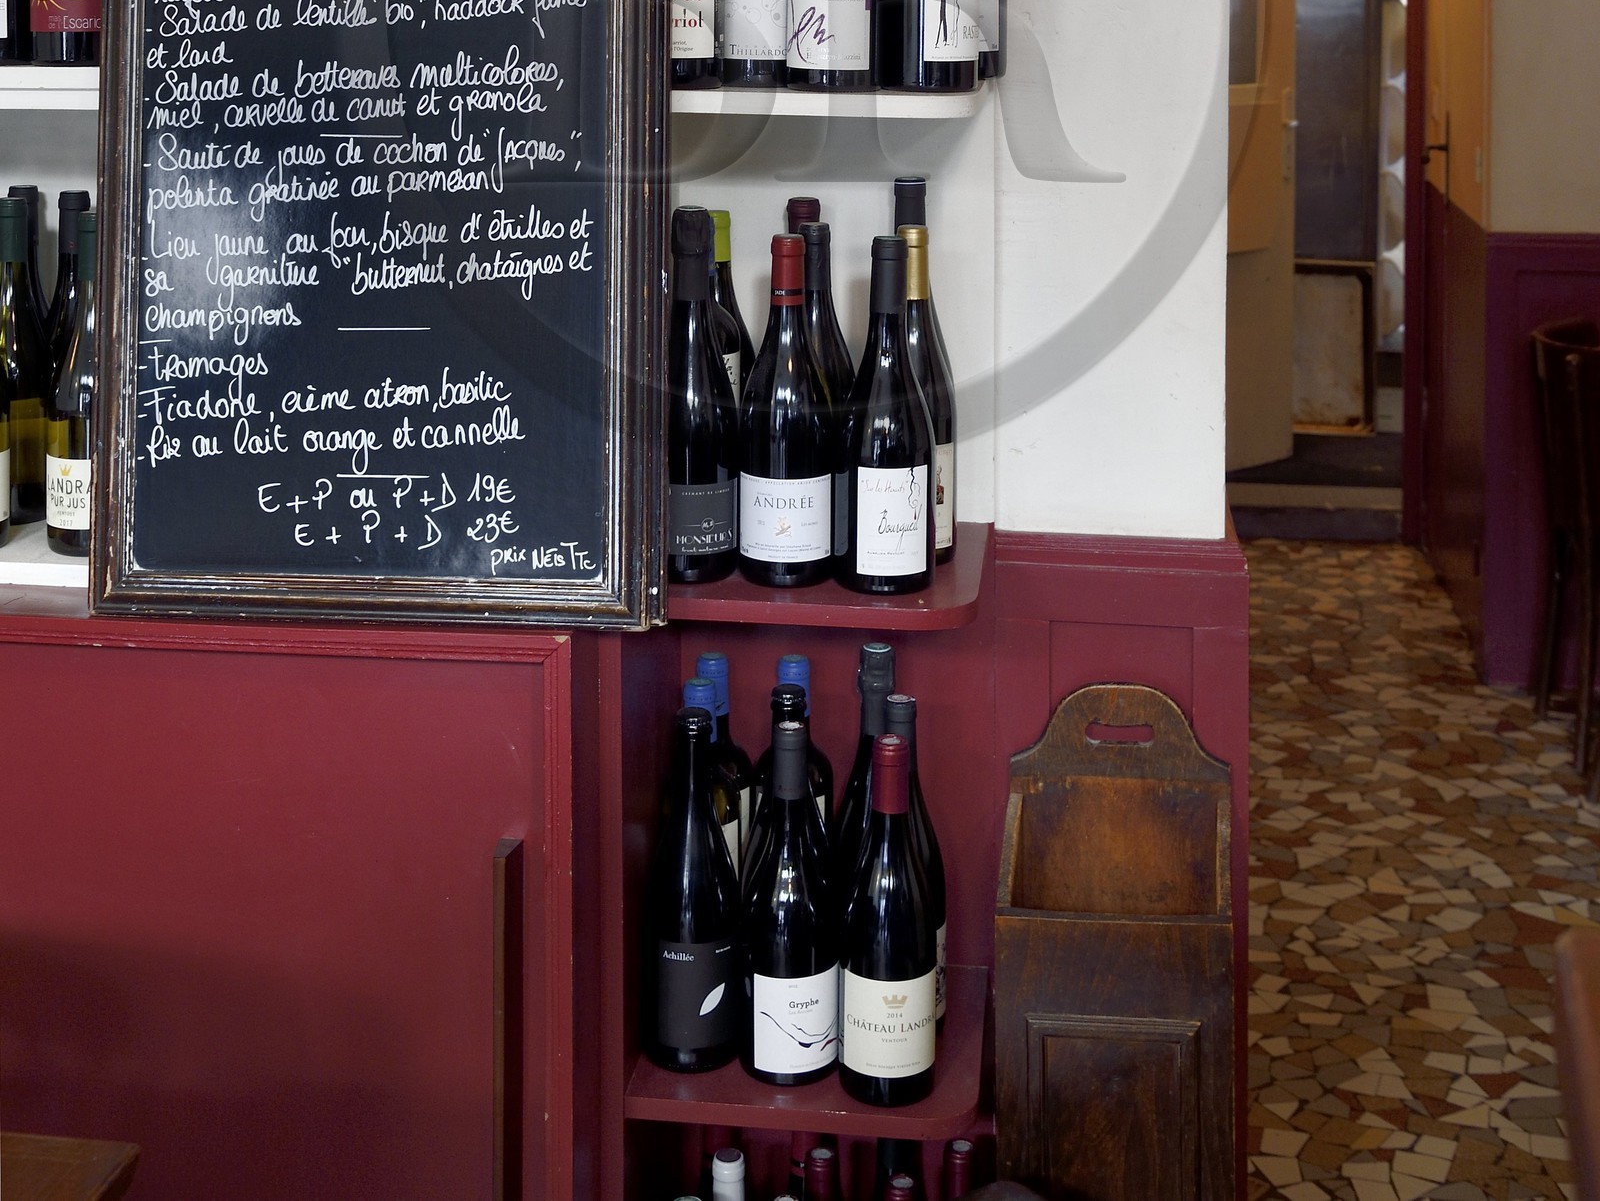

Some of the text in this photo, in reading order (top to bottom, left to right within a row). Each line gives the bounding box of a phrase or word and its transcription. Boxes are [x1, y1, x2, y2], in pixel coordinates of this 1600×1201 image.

[158, 6, 248, 38] Salade
[255, 6, 283, 31] de
[146, 38, 234, 69] et lard
[155, 70, 243, 104] Salade
[251, 68, 285, 98] de
[294, 59, 401, 98] betteraves
[223, 98, 307, 128] cervelle
[310, 97, 340, 123] de
[345, 92, 407, 122] canut
[415, 90, 442, 116] et
[449, 82, 548, 141] granola
[157, 132, 231, 171] Sauté
[234, 140, 264, 168] de
[264, 144, 327, 188] joues
[335, 135, 364, 164] de
[373, 131, 449, 164] cochon
[457, 133, 486, 166] de
[146, 174, 239, 224] polenta
[350, 175, 382, 194] au
[386, 168, 490, 203] parmesan
[149, 218, 201, 259] Lieu
[205, 233, 269, 285] jaune
[285, 233, 319, 254] au
[378, 210, 450, 261] bisque
[569, 208, 595, 240] et
[144, 268, 175, 297] sa
[568, 241, 594, 272] et
[145, 301, 303, 346] champignons
[281, 384, 357, 414] crème
[441, 366, 512, 409] basilic
[147, 405, 526, 476] Riz au lait orange et cannelle
[51, 494, 86, 509] PUR JUS
[349, 485, 378, 509] ou
[754, 494, 814, 510] ANDRÉE
[676, 528, 732, 545] MONSIEURS
[662, 949, 695, 962] Achillée
[788, 998, 820, 1010] Gryphe
[846, 1013, 896, 1033] CHÂTEAU
